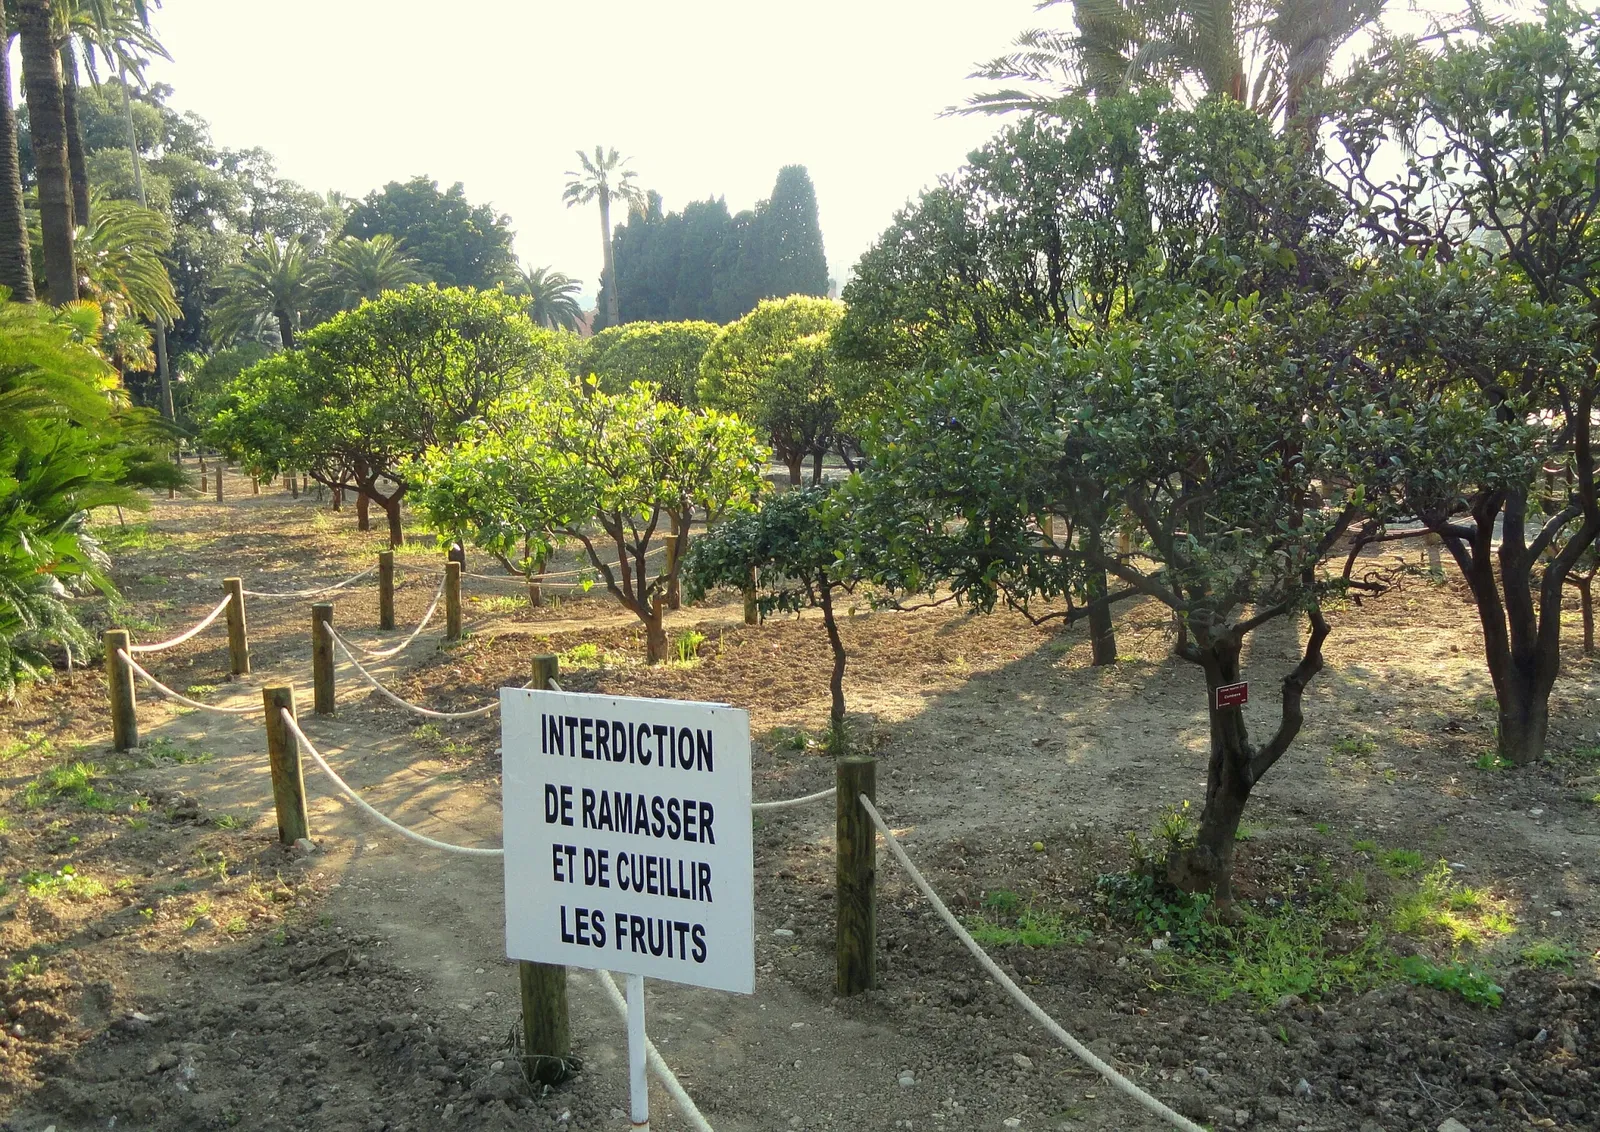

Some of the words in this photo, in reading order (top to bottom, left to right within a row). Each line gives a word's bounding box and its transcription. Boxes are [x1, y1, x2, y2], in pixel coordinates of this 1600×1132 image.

[542, 714, 713, 772] INTERDICTION
[545, 784, 573, 826] DE
[582, 788, 715, 844] RAMASSER
[553, 844, 576, 883] ET
[584, 848, 609, 888] DE
[617, 852, 712, 902] CUEILLIR
[561, 906, 606, 948] LES
[615, 913, 706, 963] FRUITS
